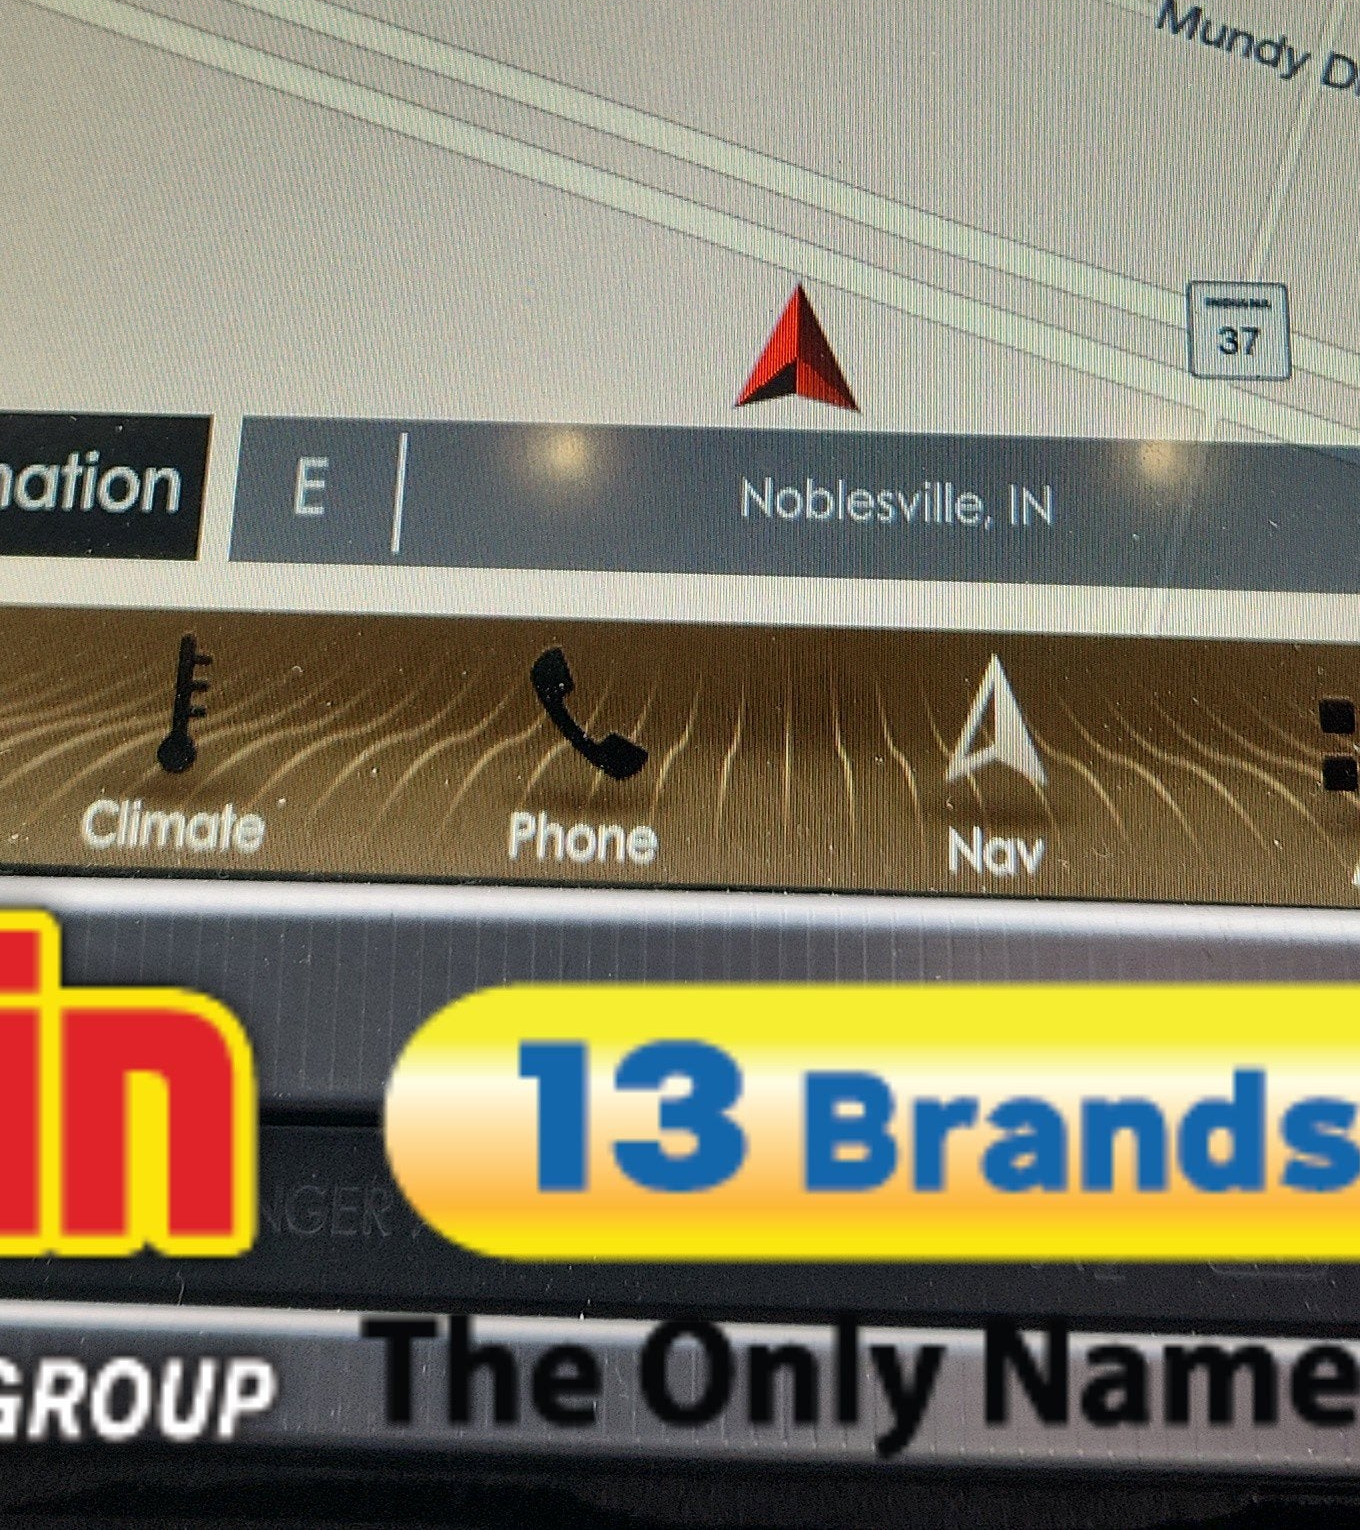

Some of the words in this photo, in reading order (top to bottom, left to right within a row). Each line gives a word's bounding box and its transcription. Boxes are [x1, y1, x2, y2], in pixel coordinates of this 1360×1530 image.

[1217, 325, 1261, 356] 37
[293, 456, 330, 517] E
[741, 476, 992, 530] Noblesville,
[1009, 483, 1054, 526] IN
[80, 798, 267, 854] Climate
[507, 810, 660, 866] Phone
[946, 825, 1045, 877] Nav
